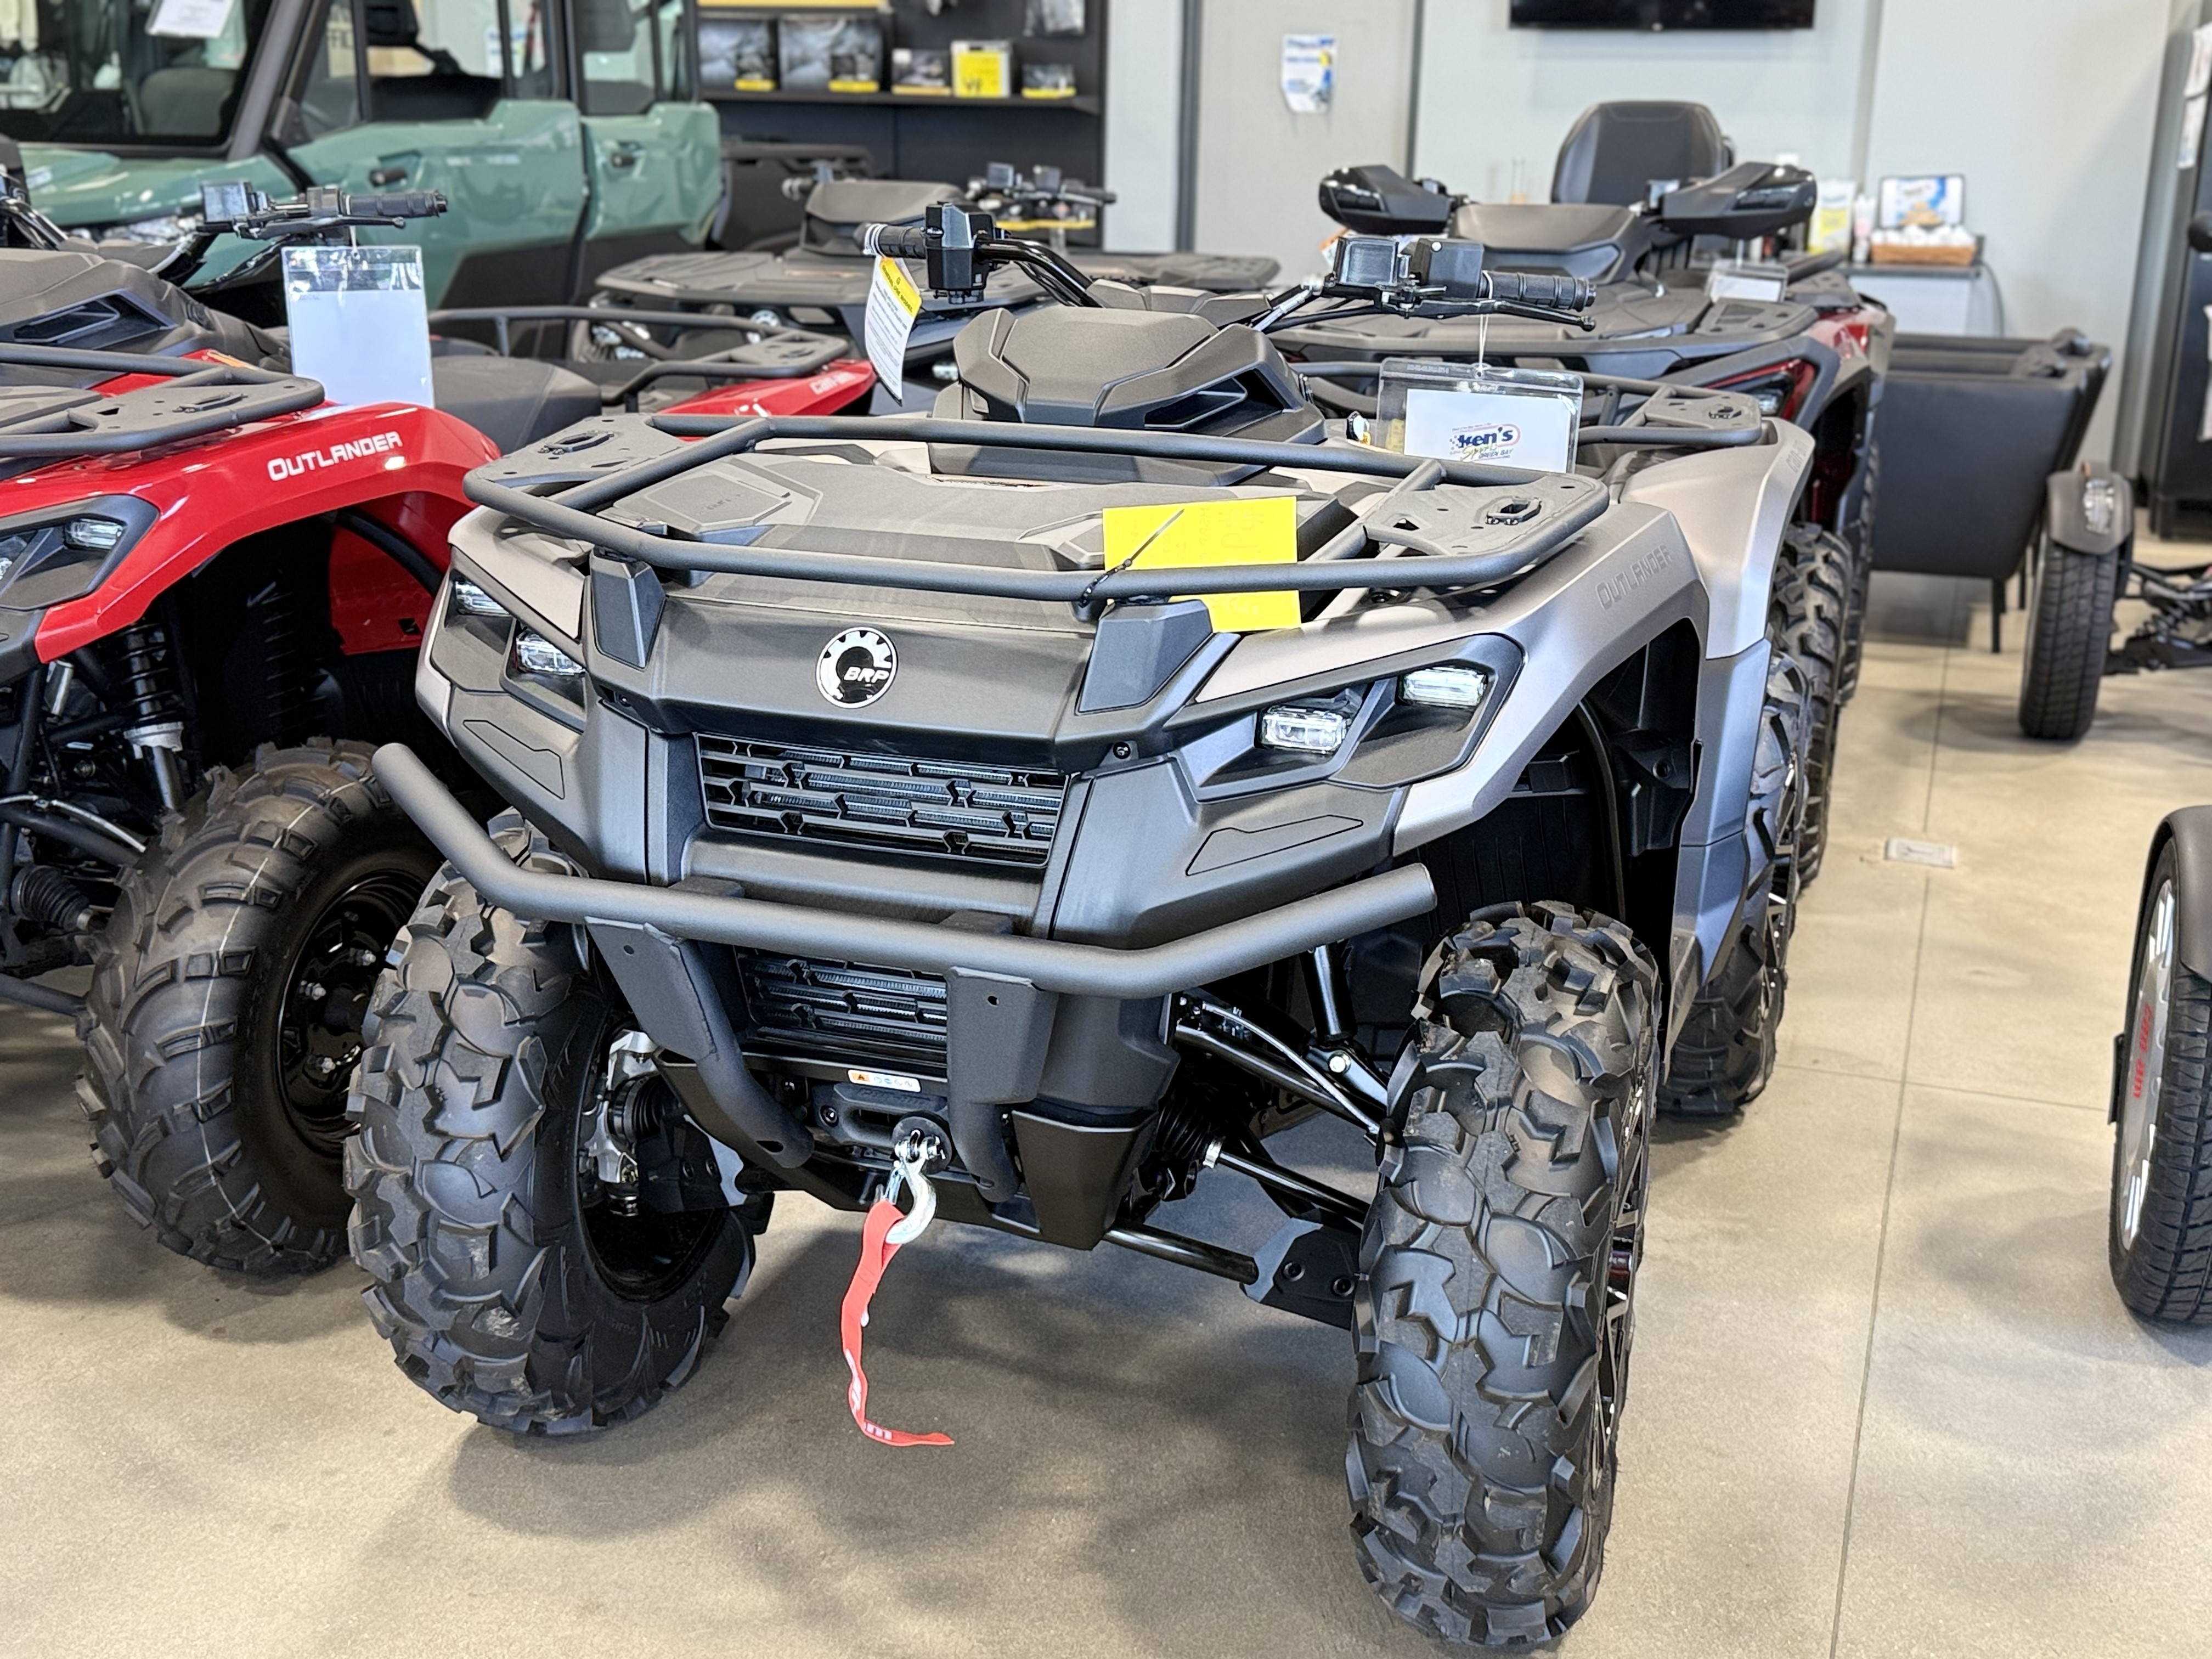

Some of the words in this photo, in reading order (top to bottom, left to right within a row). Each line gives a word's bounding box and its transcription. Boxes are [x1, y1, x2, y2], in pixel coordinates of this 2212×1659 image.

[267, 431, 403, 481] OUTLANDER
[1595, 544, 1673, 611] OUTLANDER
[843, 666, 889, 683] BRP
